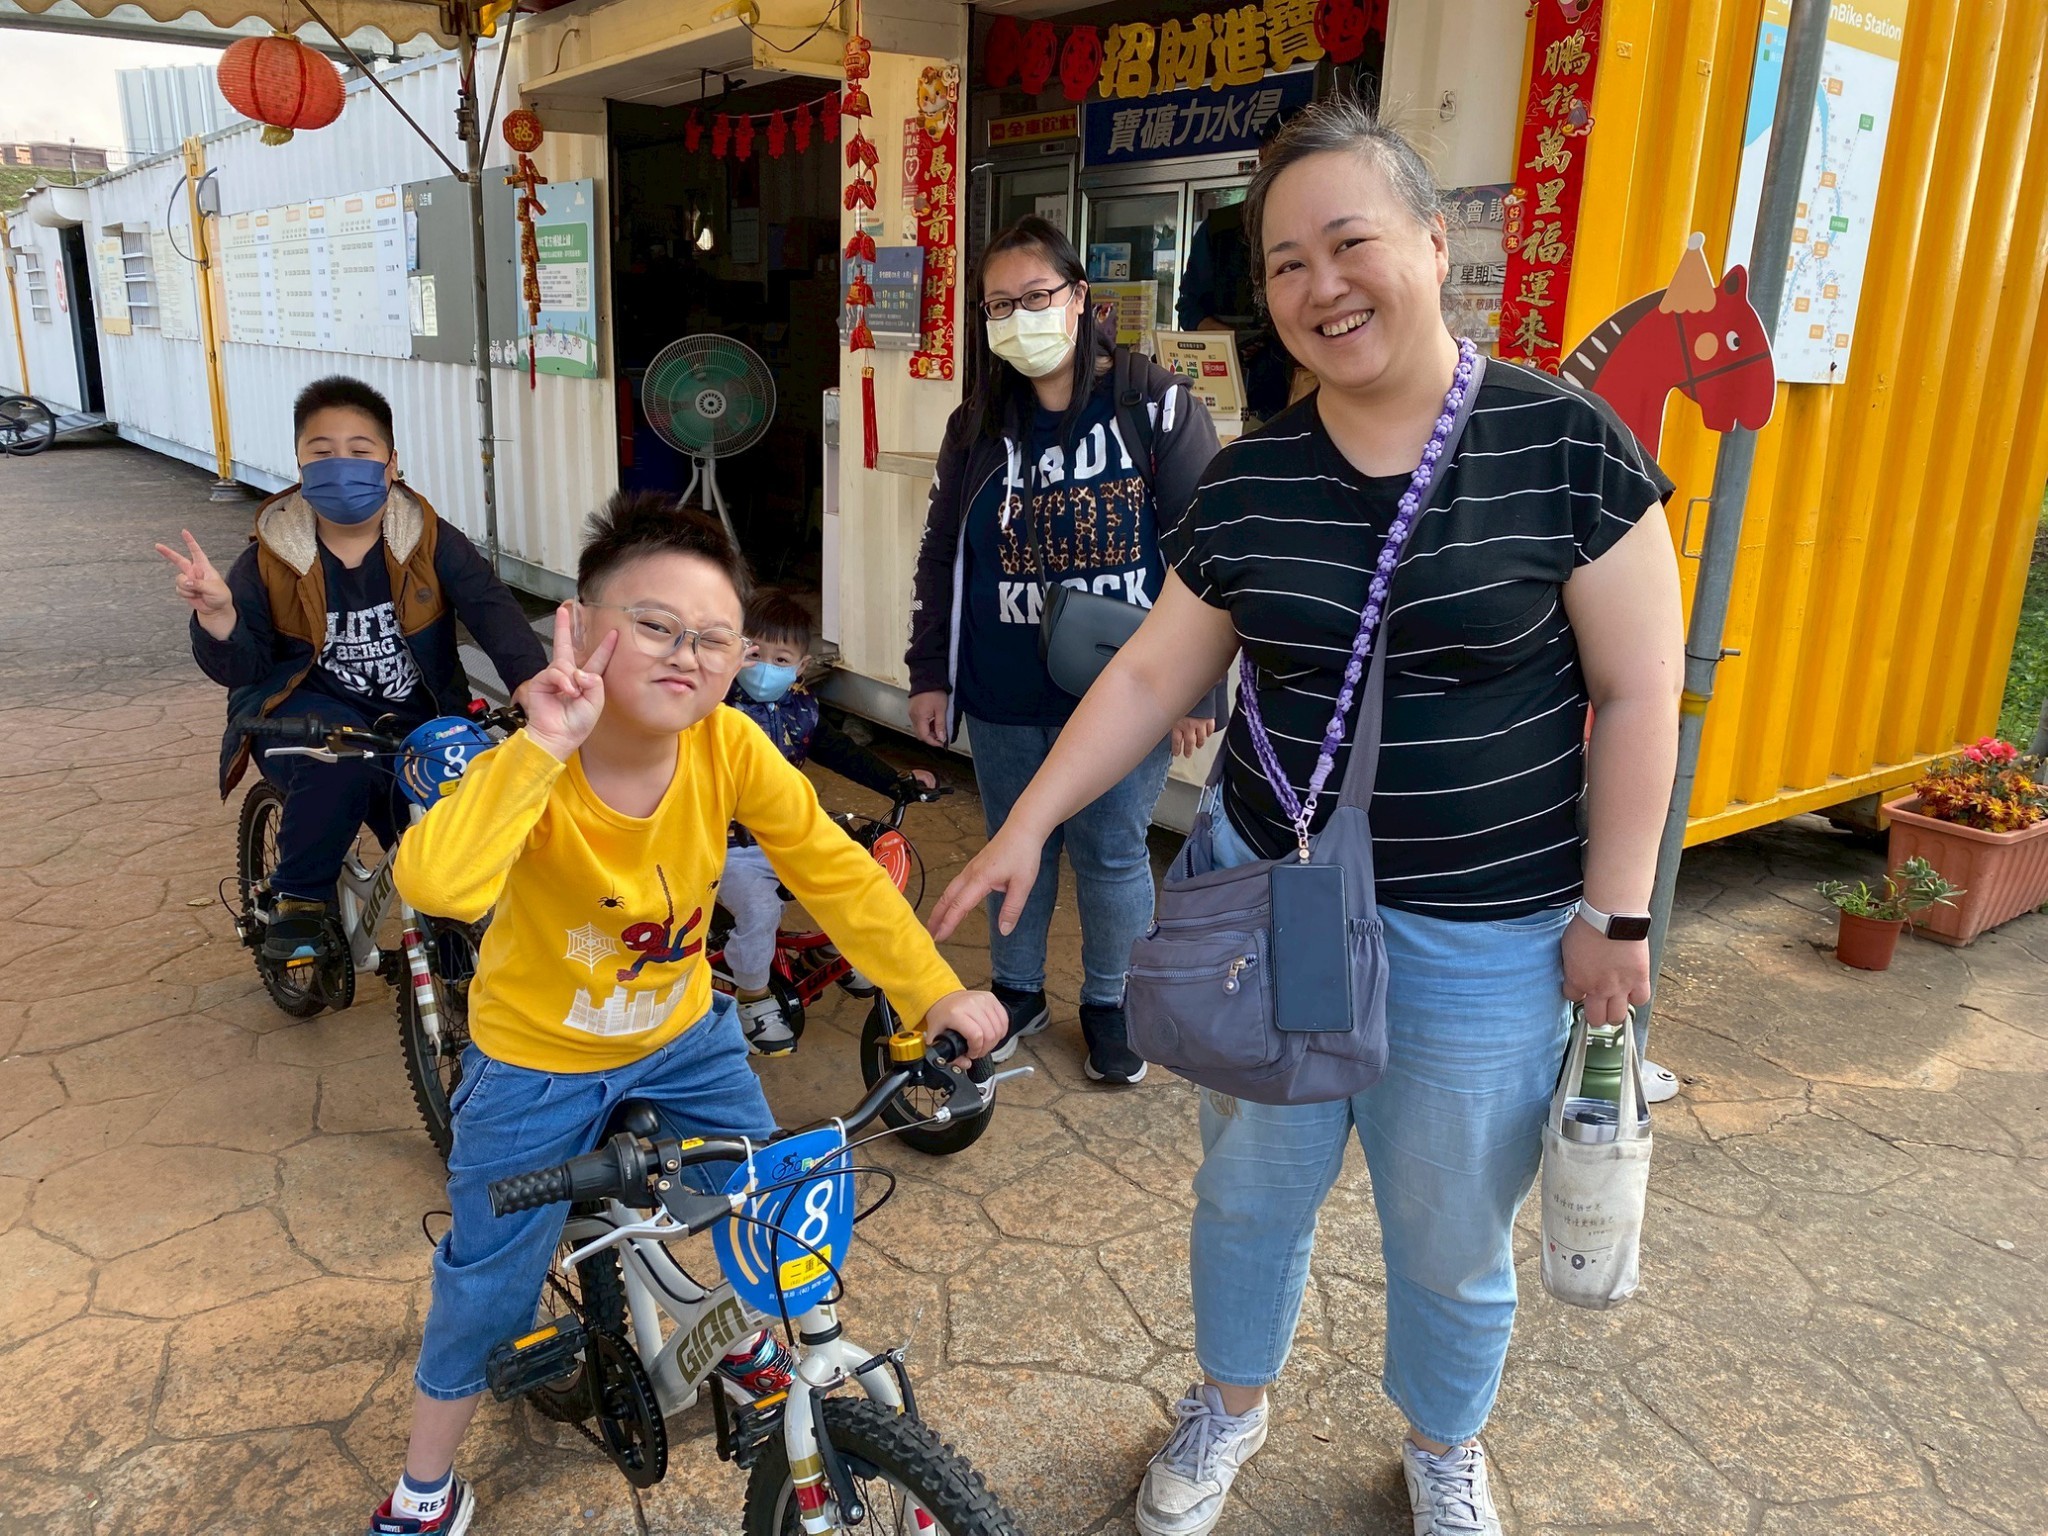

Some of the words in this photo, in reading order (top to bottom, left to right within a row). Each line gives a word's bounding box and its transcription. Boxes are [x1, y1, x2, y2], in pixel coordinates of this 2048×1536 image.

[1099, 0, 1325, 99] 招財進寶
[1864, 13, 1902, 41] Station
[1107, 88, 1283, 156] 寶礦力水得
[1511, 28, 1591, 356] 鵬程萬里福運來
[1115, 263, 1127, 277] 20
[325, 601, 399, 643] LIFE
[335, 637, 396, 661] BEING
[444, 741, 467, 777] 8
[361, 861, 394, 938] GIAN
[796, 1178, 833, 1249] 8
[676, 1296, 763, 1385] GIAN
